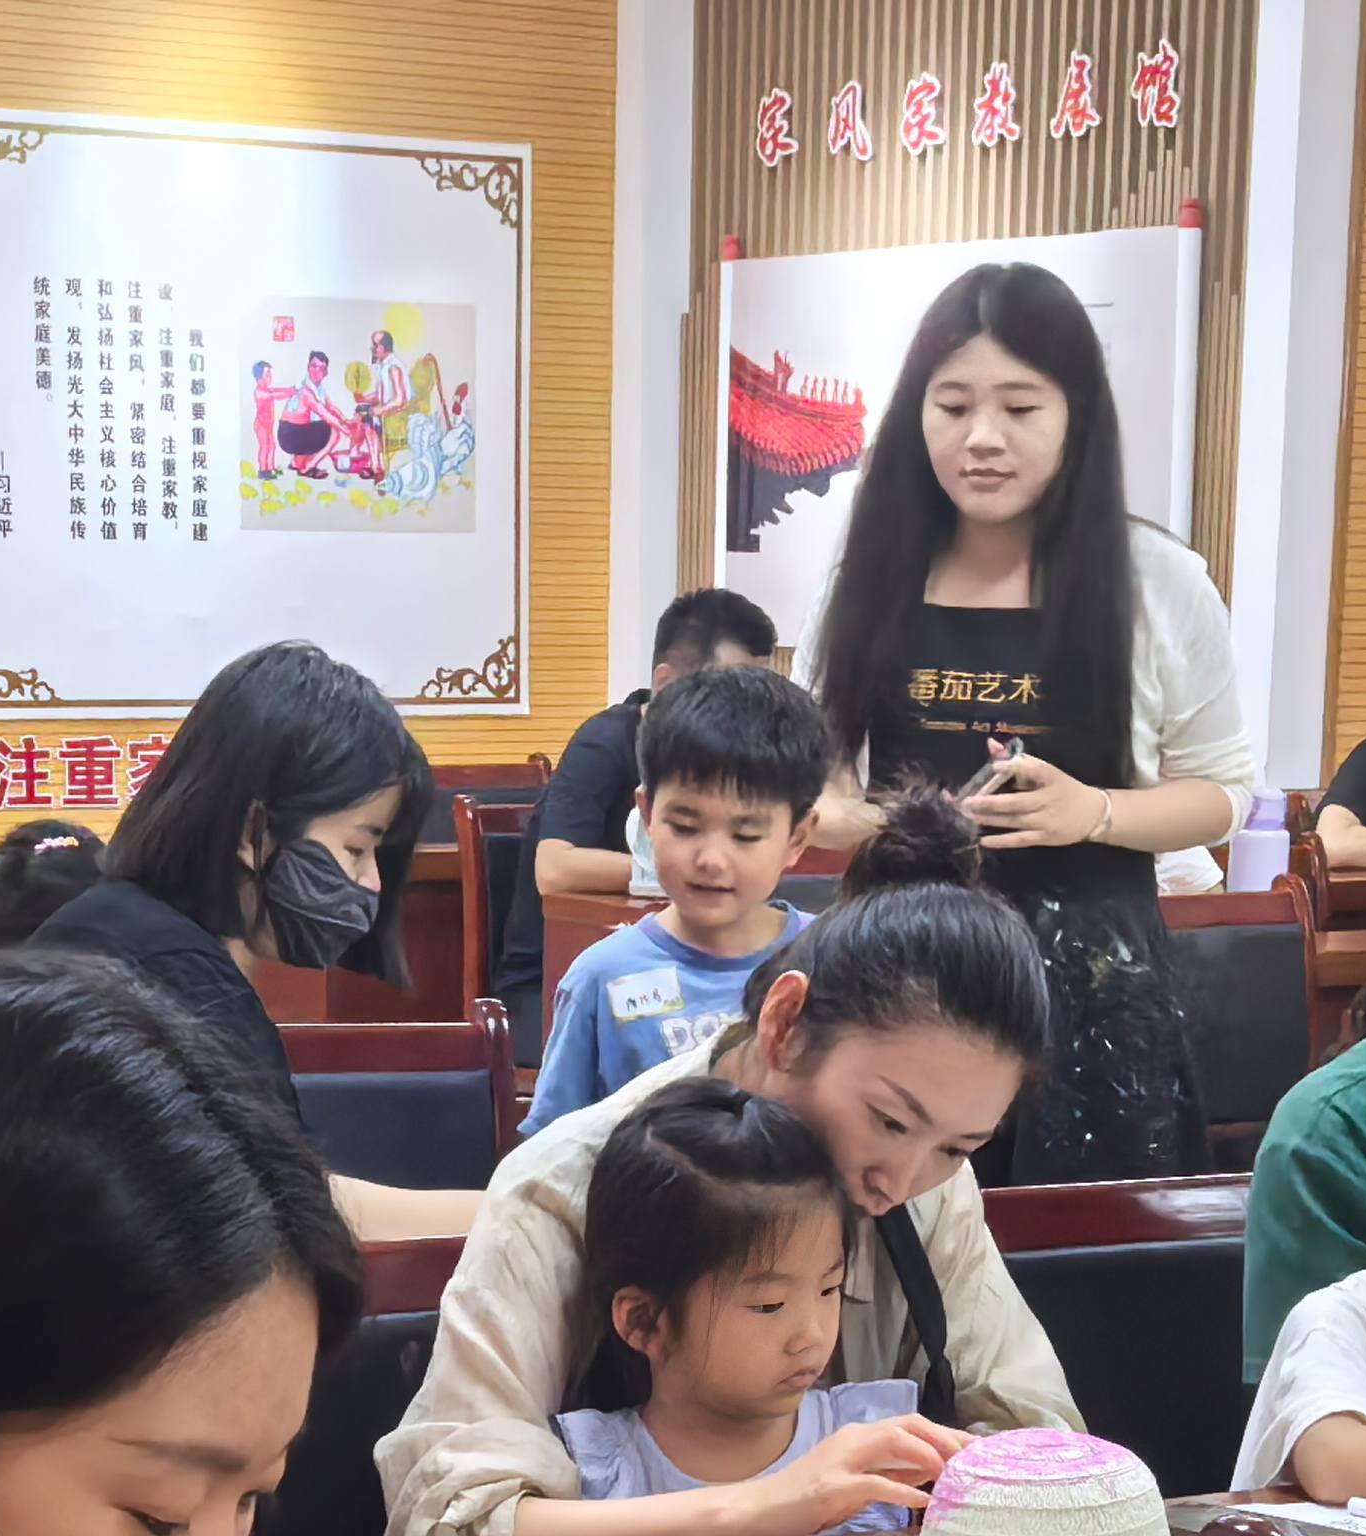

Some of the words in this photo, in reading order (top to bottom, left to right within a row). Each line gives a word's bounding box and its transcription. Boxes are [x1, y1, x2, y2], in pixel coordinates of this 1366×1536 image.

[98, 279, 117, 541] 和弘扬社会主义核心价值
[188, 328, 208, 542] 我们都要重视家庭建
[907, 668, 1046, 707] 番茄艺术
